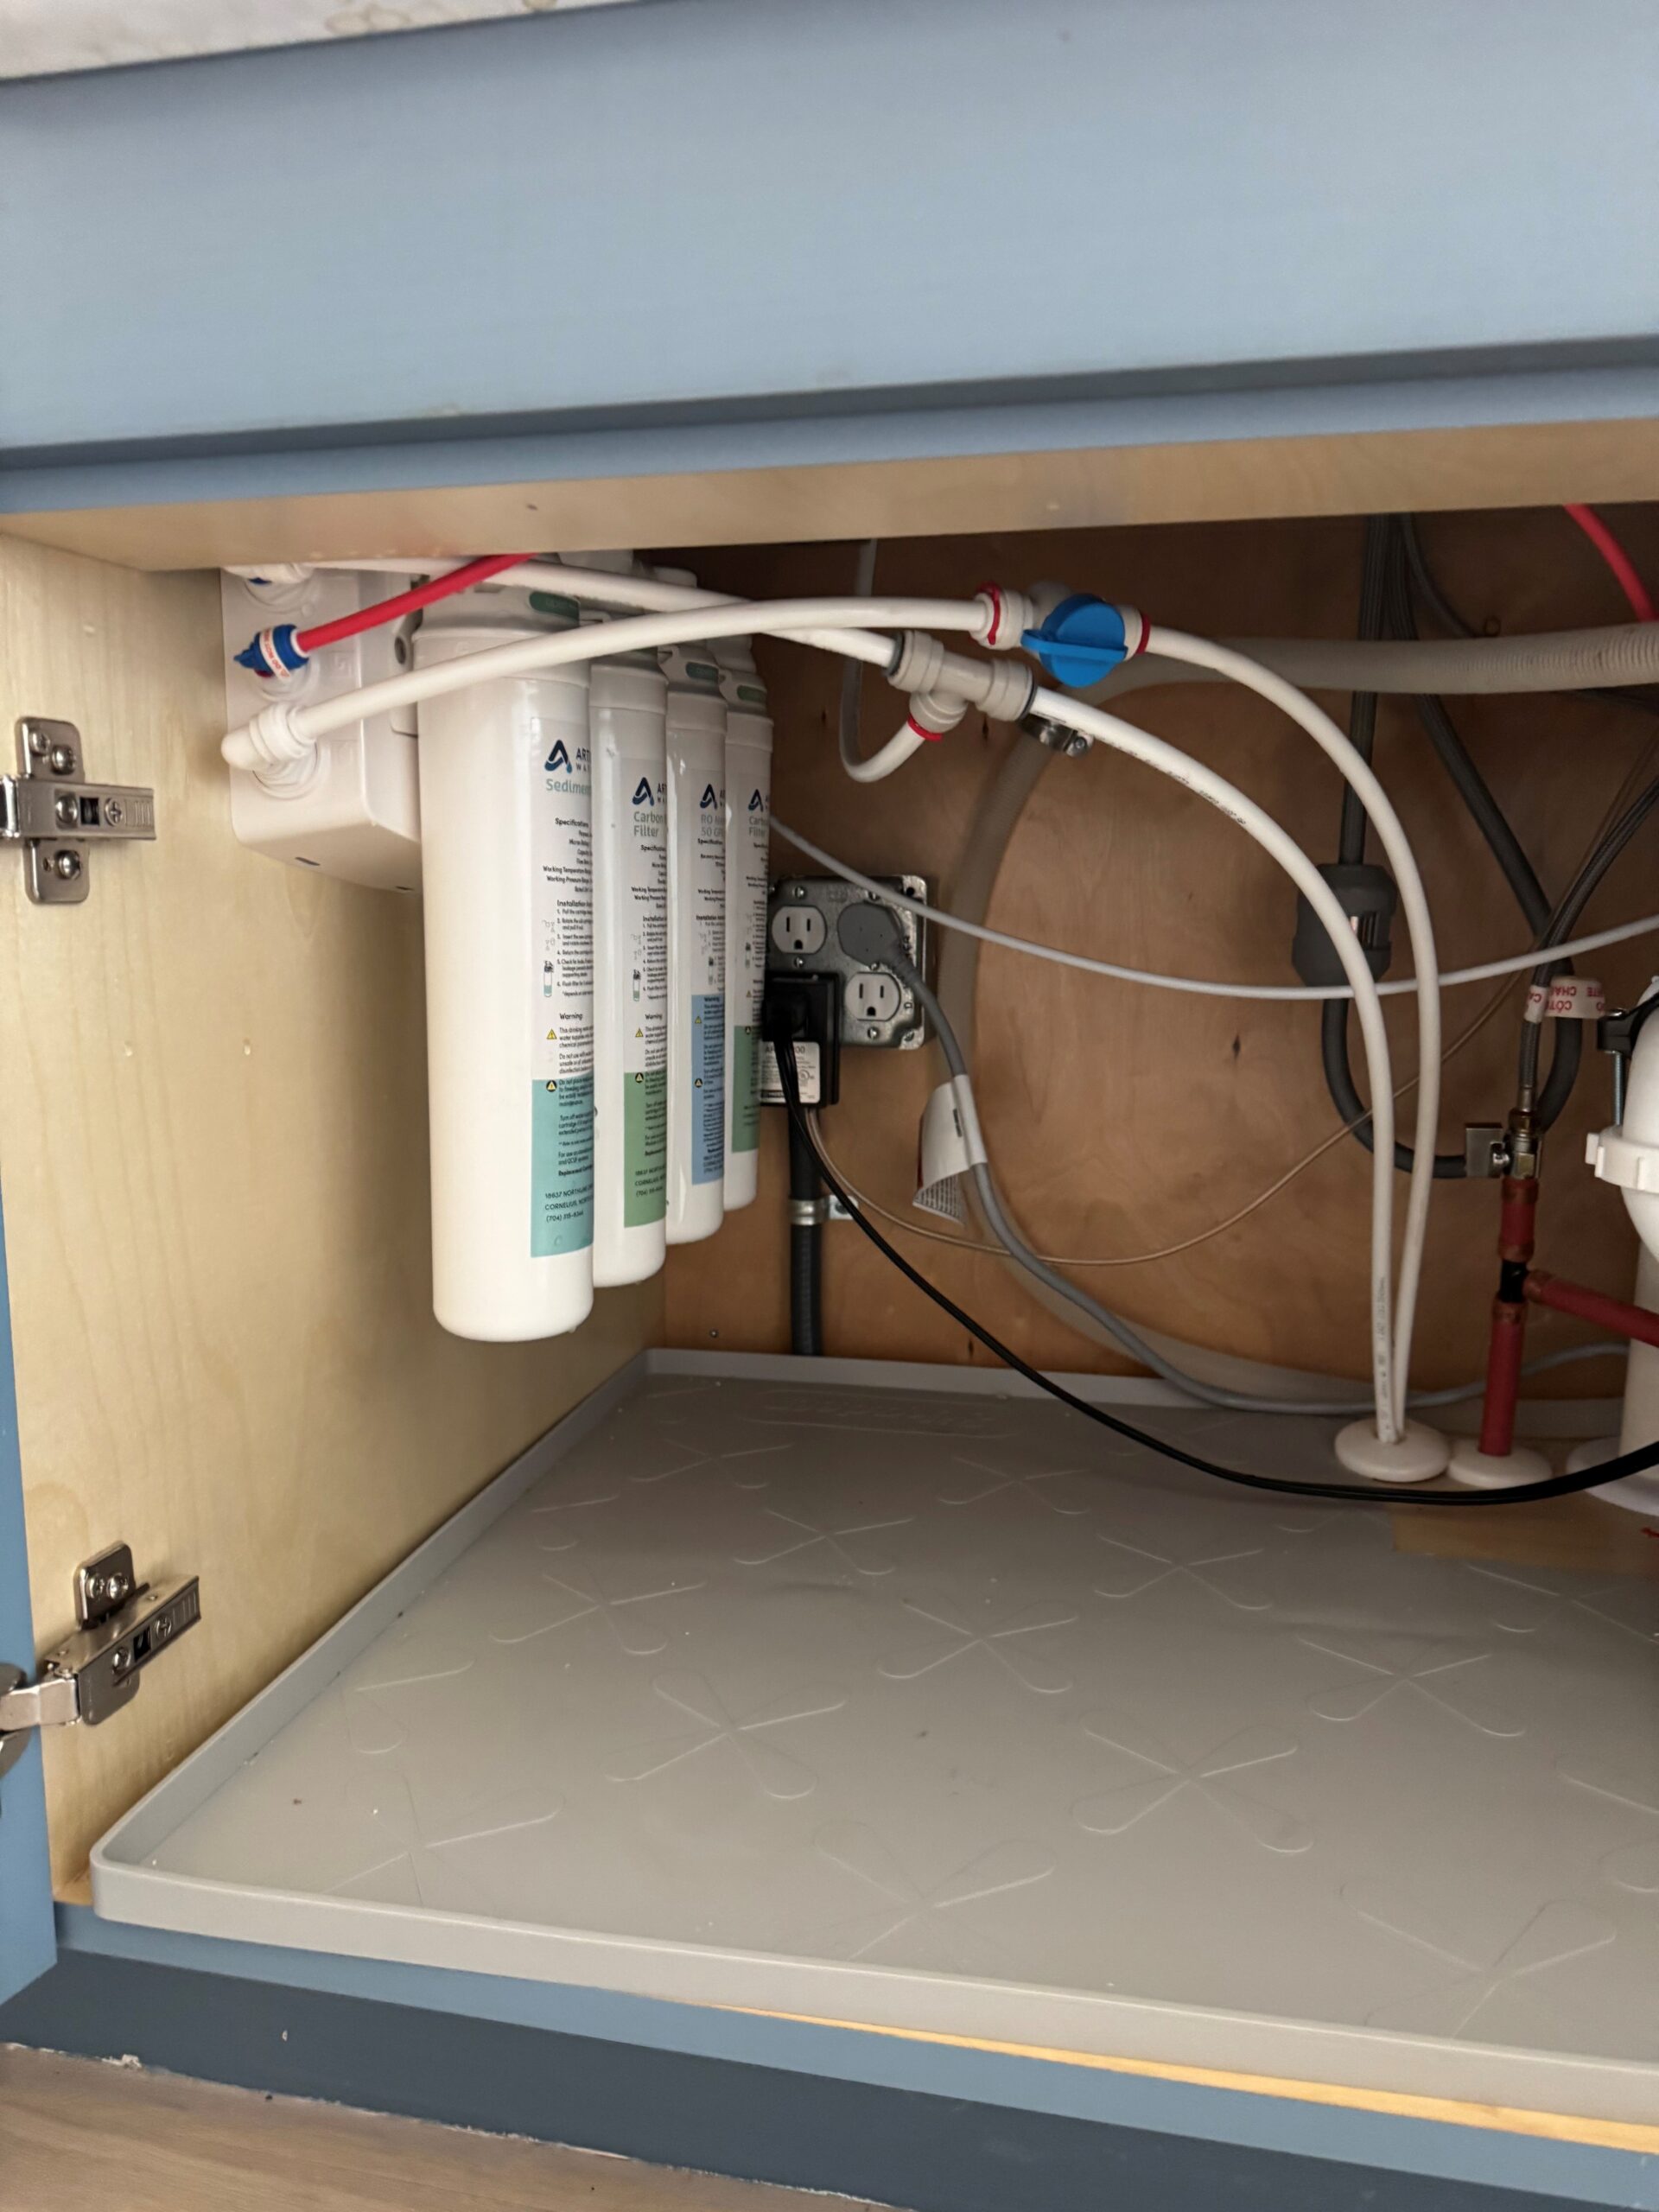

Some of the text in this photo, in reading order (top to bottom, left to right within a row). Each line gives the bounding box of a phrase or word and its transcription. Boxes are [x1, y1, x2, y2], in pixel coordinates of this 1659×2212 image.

[633, 810, 664, 823] Carbon
[701, 814, 713, 825] RO
[633, 824, 658, 837] Filter
[560, 1013, 583, 1021] Warning
